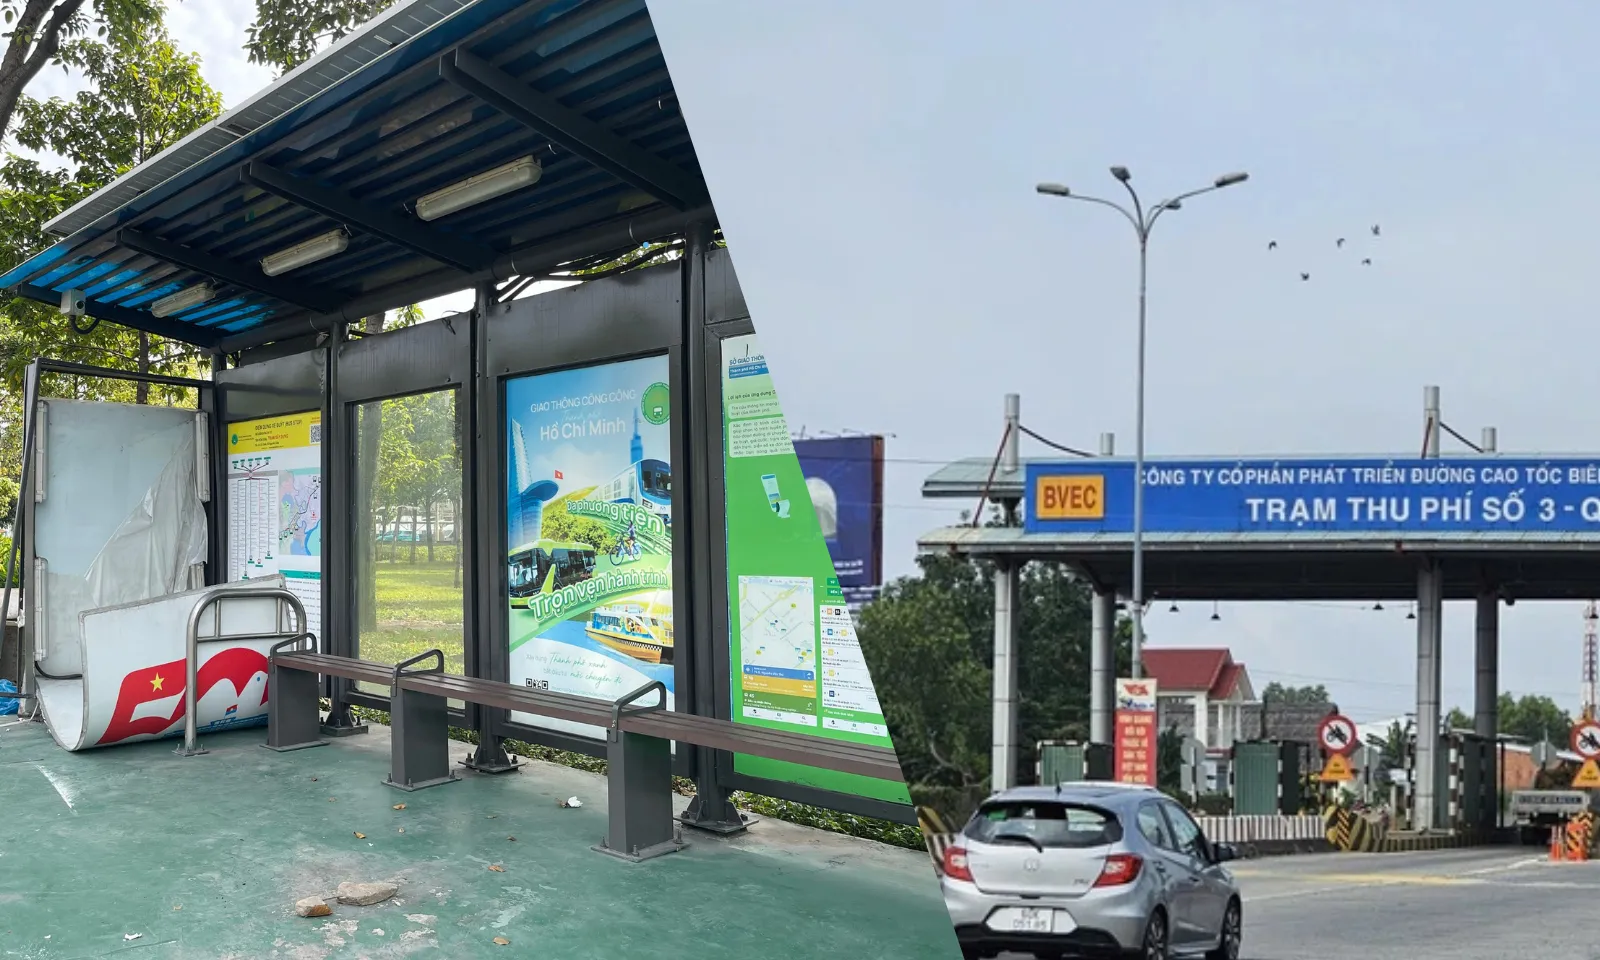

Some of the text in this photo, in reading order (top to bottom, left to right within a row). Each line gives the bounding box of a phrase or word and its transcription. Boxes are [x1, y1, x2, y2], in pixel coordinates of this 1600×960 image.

[530, 388, 637, 413] GIAO THÔNG CÔNG CỘNG
[540, 417, 626, 441] Hồ Chí Minh
[1190, 468, 1214, 484] TY
[1299, 463, 1346, 484] PHÁT
[1352, 458, 1405, 484] TRIỂN
[1411, 462, 1476, 484] ĐƯỜNG
[1481, 468, 1518, 484] CAO
[1525, 461, 1562, 484] TỐC
[1043, 486, 1096, 509] BVEC
[1246, 497, 1336, 526] TRẠM
[1347, 497, 1410, 522] THU
[1420, 490, 1474, 522] PHÍ
[1482, 488, 1525, 522] SỐ
[1539, 498, 1556, 522] 3
[578, 500, 620, 520] phương
[622, 504, 664, 534] tiện
[530, 568, 668, 617] Trọn vẹn hành trình
